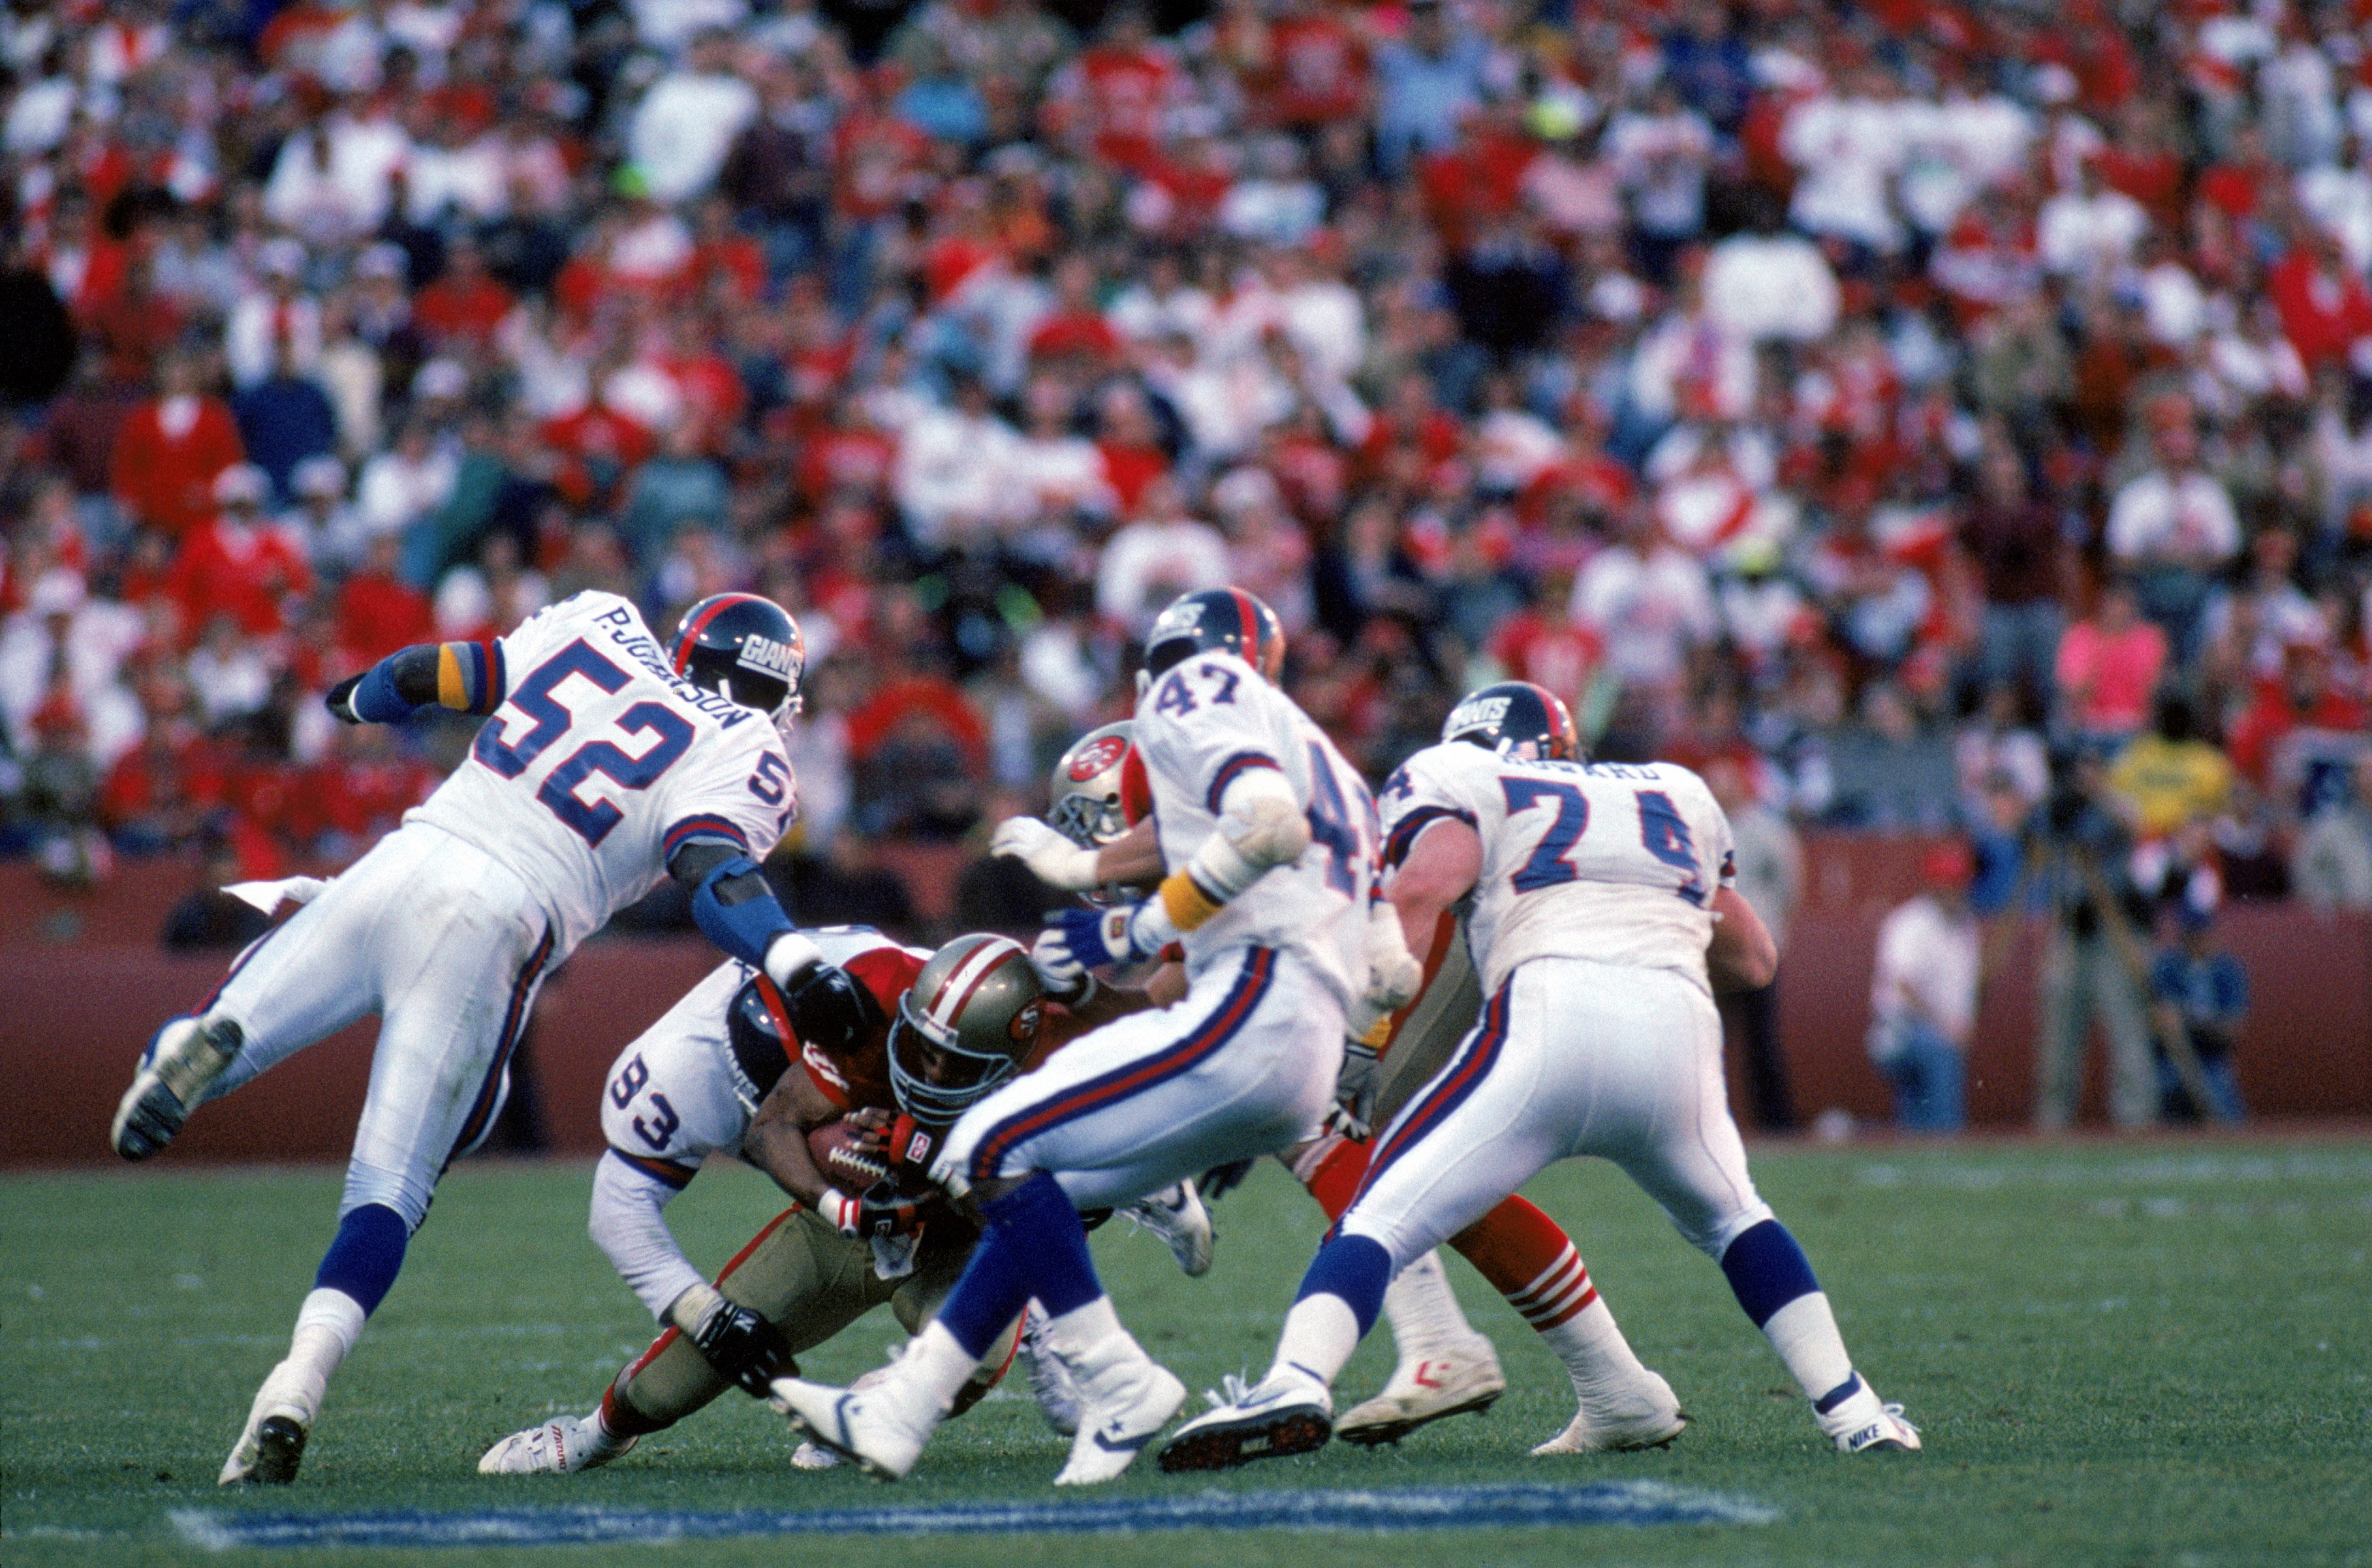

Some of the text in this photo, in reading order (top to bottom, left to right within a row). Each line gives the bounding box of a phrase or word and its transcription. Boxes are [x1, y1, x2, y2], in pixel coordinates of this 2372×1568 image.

[591, 606, 754, 730] P.JOSON
[1155, 663, 1240, 716] 47
[473, 636, 695, 849] 52
[1497, 775, 1706, 909] 74
[610, 1051, 680, 1151] 93
[1848, 1423, 1880, 1449] NIKE
